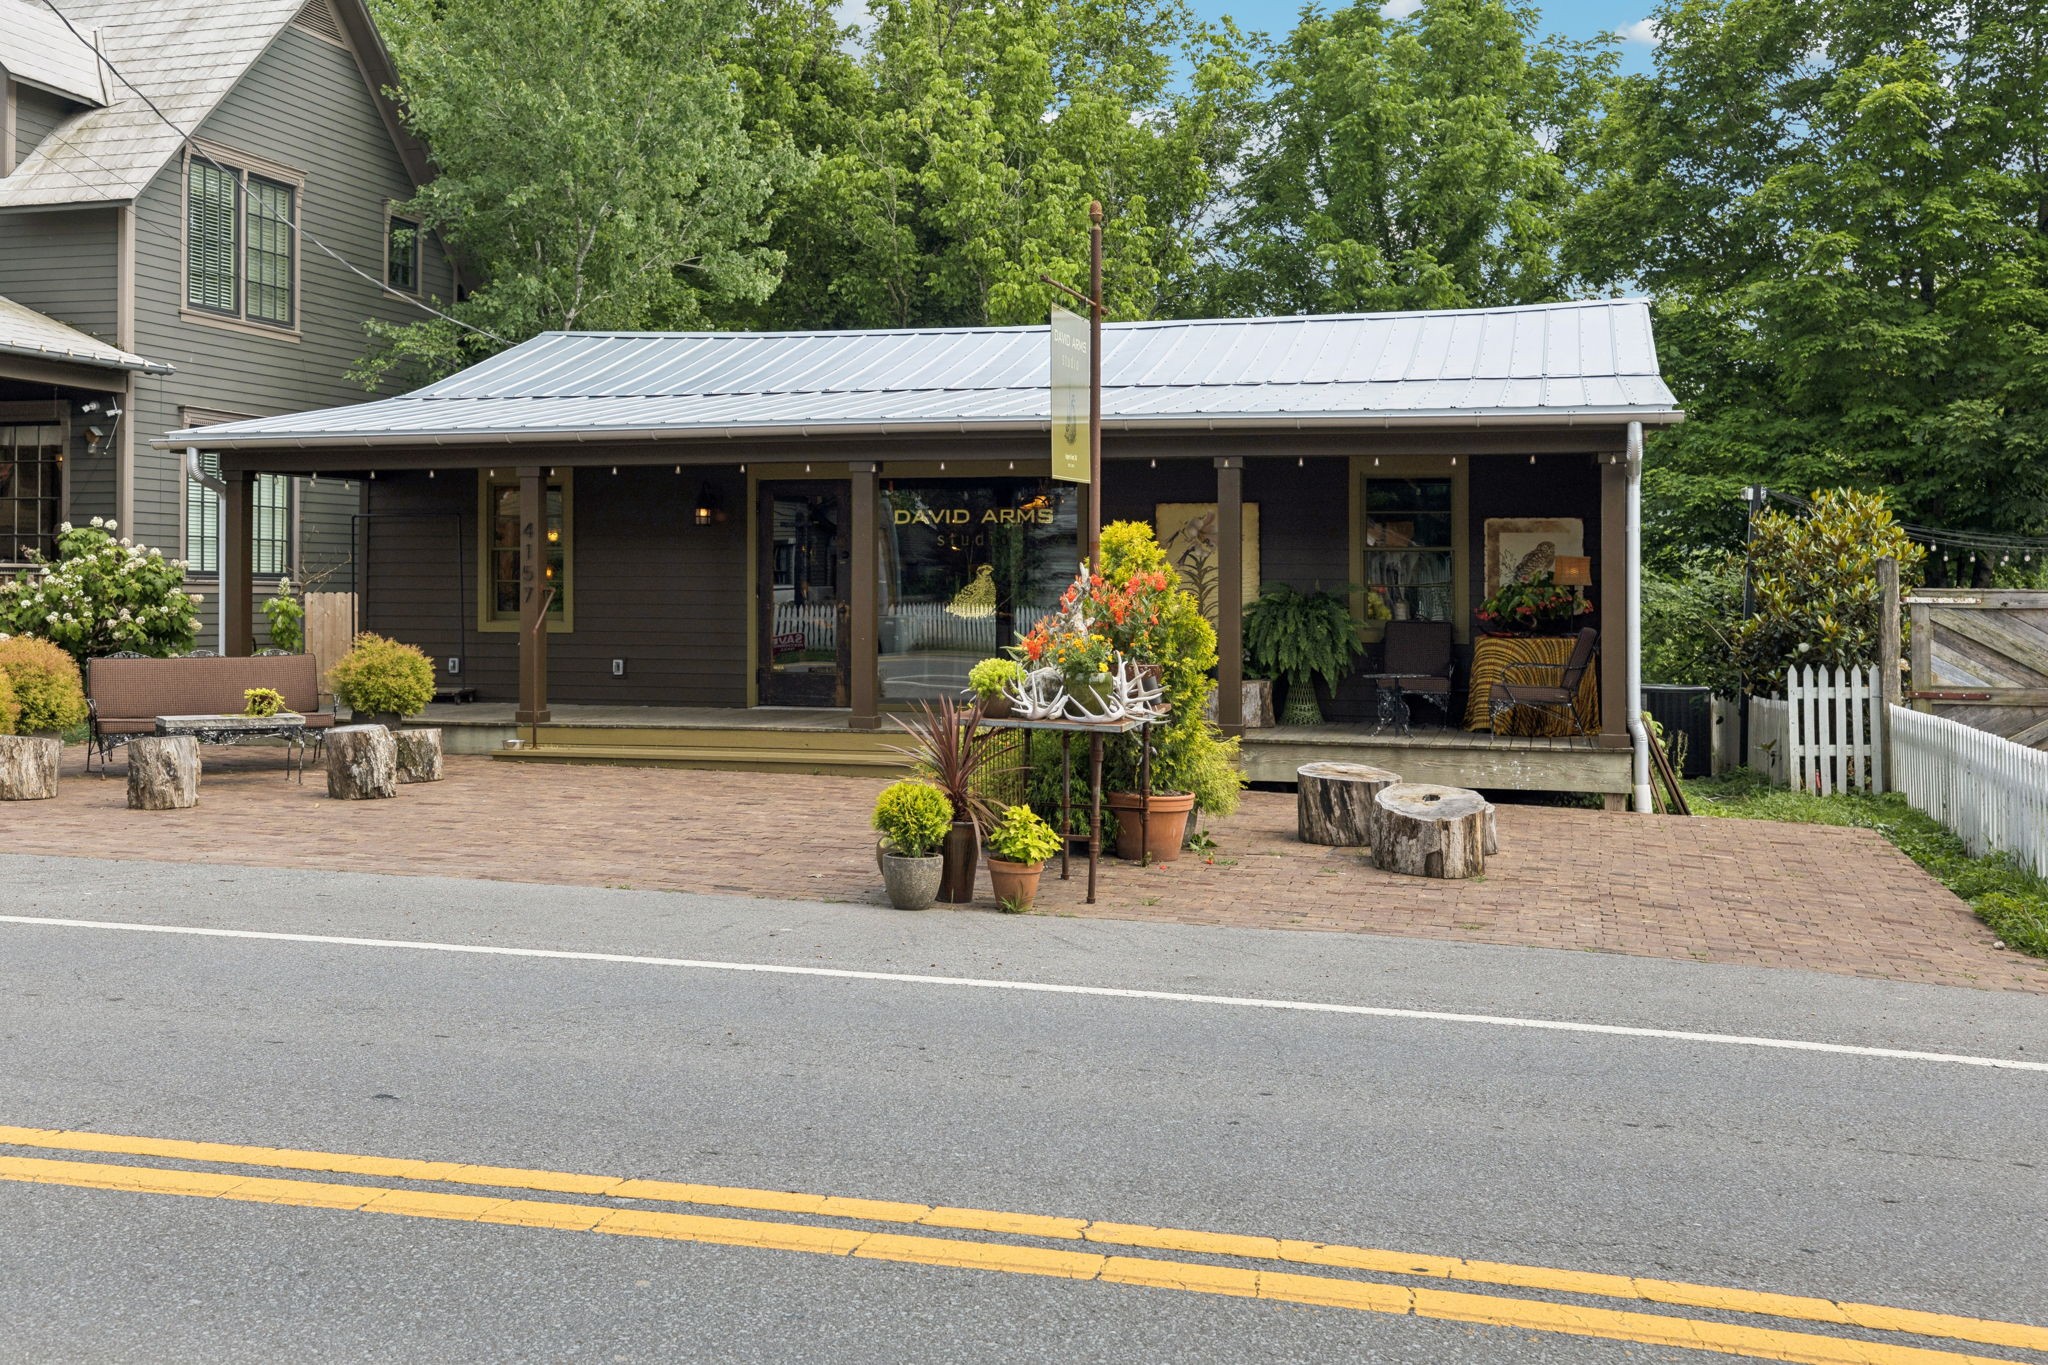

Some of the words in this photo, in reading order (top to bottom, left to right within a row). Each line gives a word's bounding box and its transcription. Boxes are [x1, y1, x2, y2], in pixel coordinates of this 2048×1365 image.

[1053, 328, 1070, 347] DAVID
[1071, 336, 1087, 354] ARMS
[895, 509, 969, 524] DAVID
[981, 508, 1053, 524] ARMS
[523, 522, 534, 603] 4157
